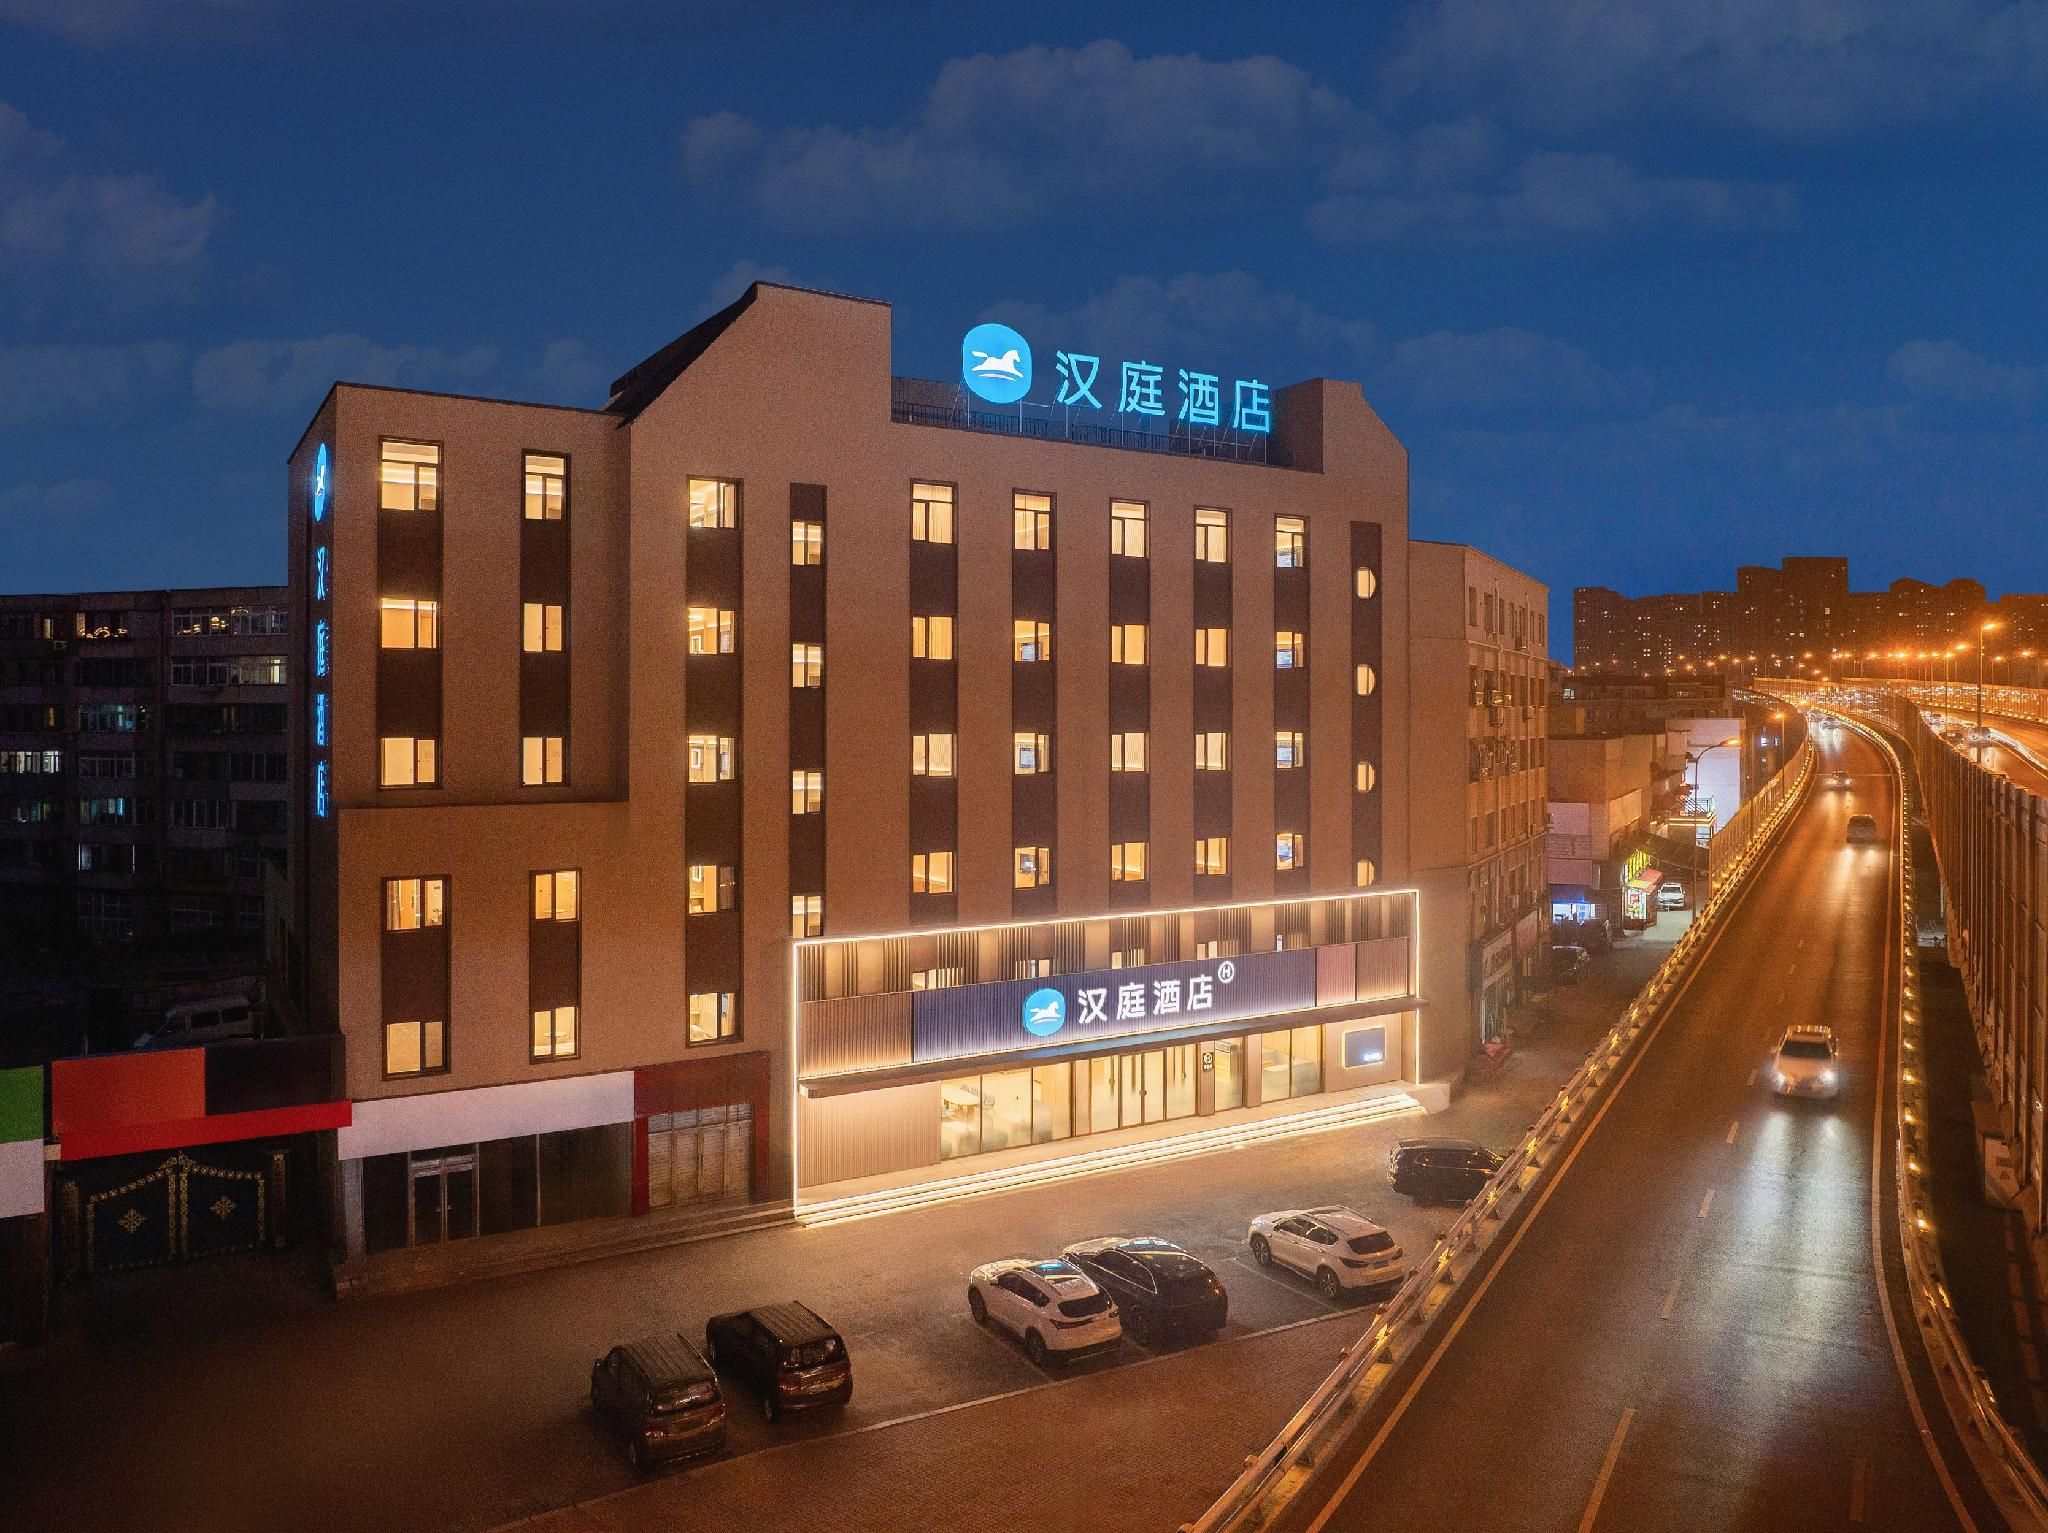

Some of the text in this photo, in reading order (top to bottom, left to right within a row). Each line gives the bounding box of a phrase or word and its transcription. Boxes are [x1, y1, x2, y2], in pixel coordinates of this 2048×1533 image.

[1055, 350, 1270, 433] 汉庭酒店
[1078, 974, 1213, 1024] 汉庭酒店
